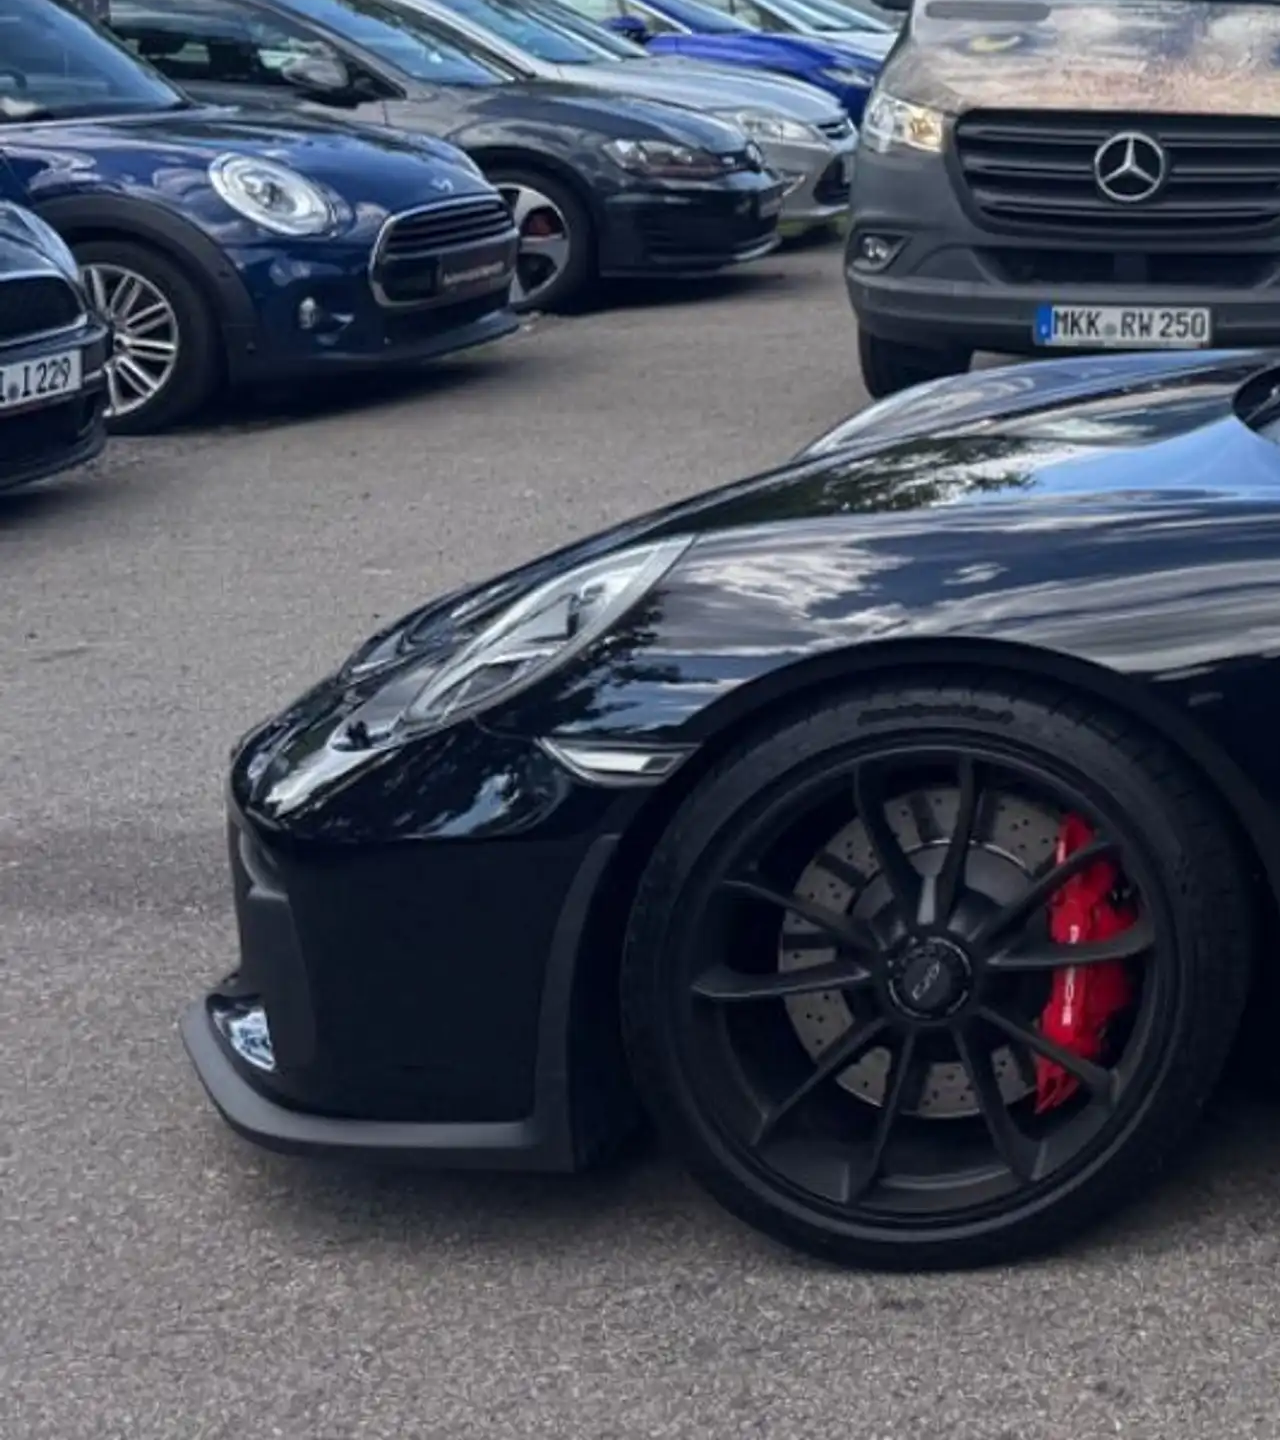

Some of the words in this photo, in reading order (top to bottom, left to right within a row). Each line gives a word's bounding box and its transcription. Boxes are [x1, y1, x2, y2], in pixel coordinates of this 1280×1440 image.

[1053, 310, 1102, 336] MKK
[1120, 312, 1153, 338] RW
[1159, 312, 1206, 339] 250
